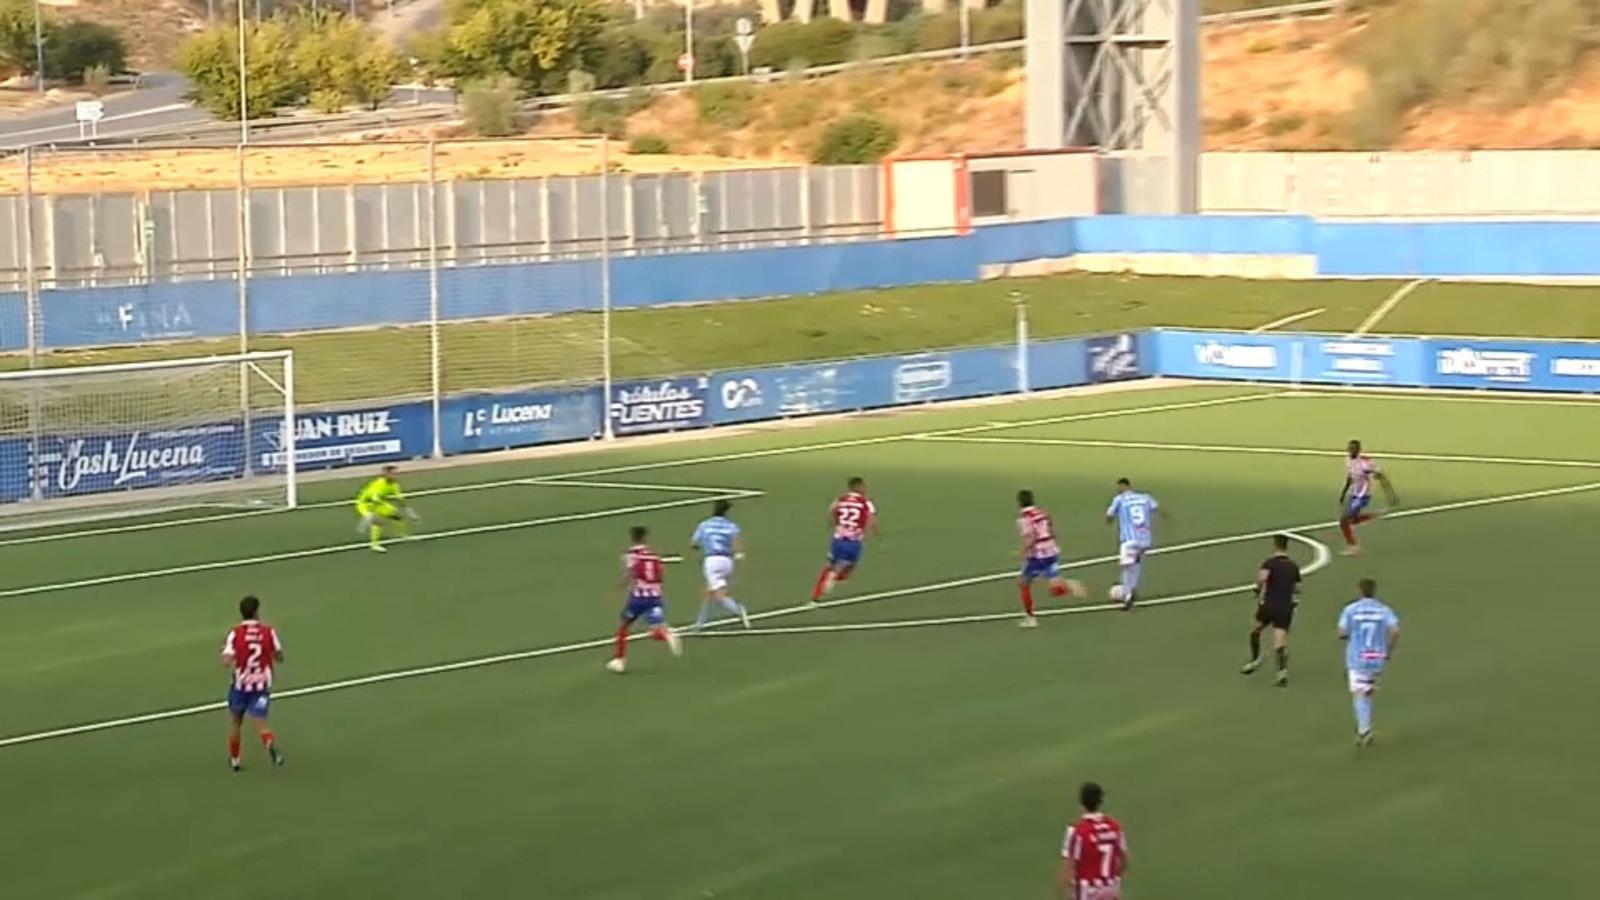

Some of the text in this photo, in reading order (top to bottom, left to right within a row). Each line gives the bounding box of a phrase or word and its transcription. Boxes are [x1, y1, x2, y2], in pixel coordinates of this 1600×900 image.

[335, 410, 391, 438] RUIZ
[491, 402, 553, 425] Lucena
[113, 430, 205, 485] Lucena
[838, 507, 861, 526] 22
[1129, 504, 1146, 525] 9
[1360, 622, 1377, 648] 7
[247, 642, 262, 668] 2
[1098, 844, 1114, 878] 7
